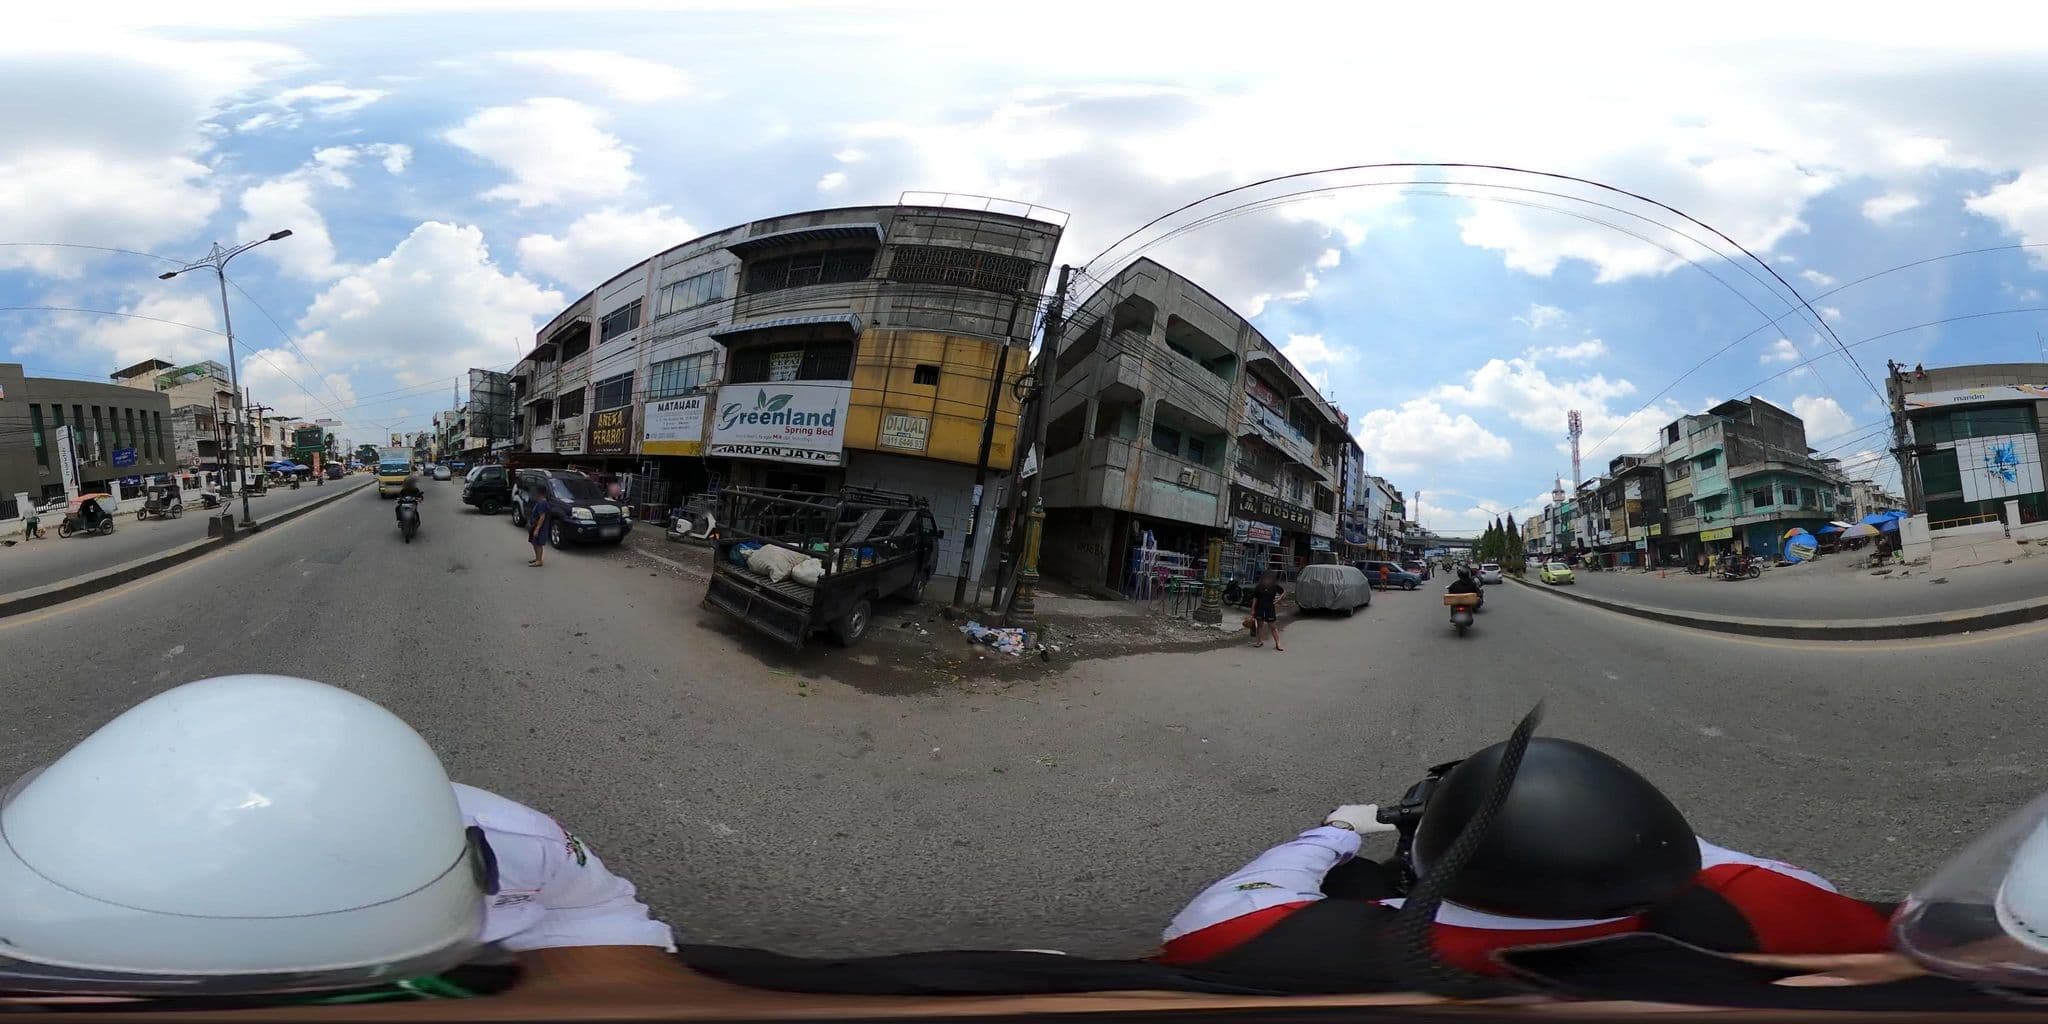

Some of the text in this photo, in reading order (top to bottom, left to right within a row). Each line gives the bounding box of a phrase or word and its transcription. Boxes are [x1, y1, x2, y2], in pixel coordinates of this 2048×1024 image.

[657, 400, 700, 412] MATAHARI
[718, 403, 837, 431] Greenland
[886, 416, 924, 434] DIJUAL
[593, 428, 627, 445] PERABOT
[785, 426, 813, 437] Spring
[815, 427, 835, 437] Bed
[1262, 502, 1310, 525] MODERN
